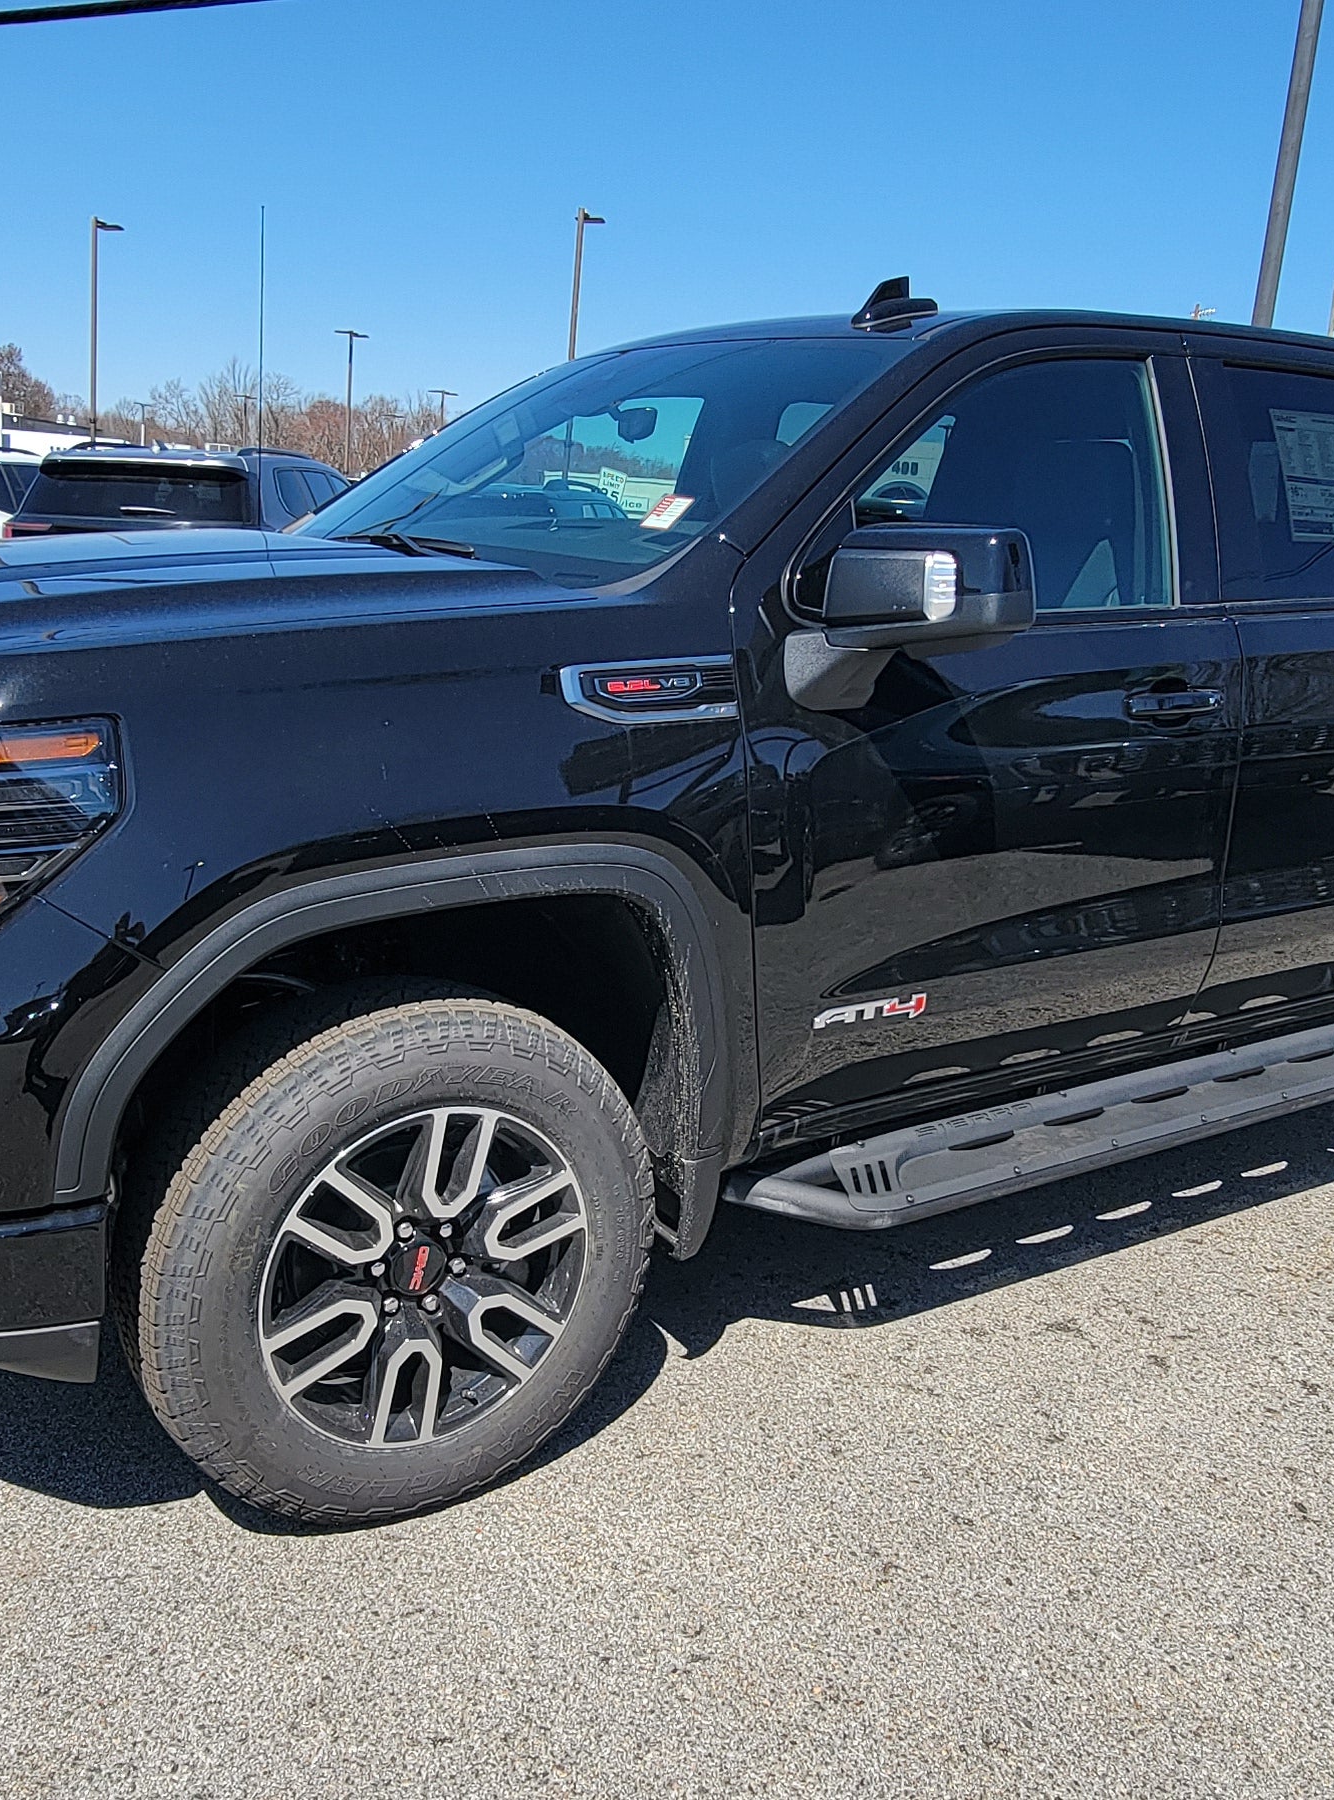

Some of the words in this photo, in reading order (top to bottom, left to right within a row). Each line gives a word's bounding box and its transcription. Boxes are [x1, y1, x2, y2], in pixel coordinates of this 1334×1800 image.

[892, 461, 918, 476] 400
[812, 992, 927, 1030] AT4
[268, 1064, 579, 1194] GOODYEAR
[914, 1102, 1033, 1137] SIERRA
[409, 1245, 430, 1290] GMC
[295, 1370, 585, 1499] WRANGLER
